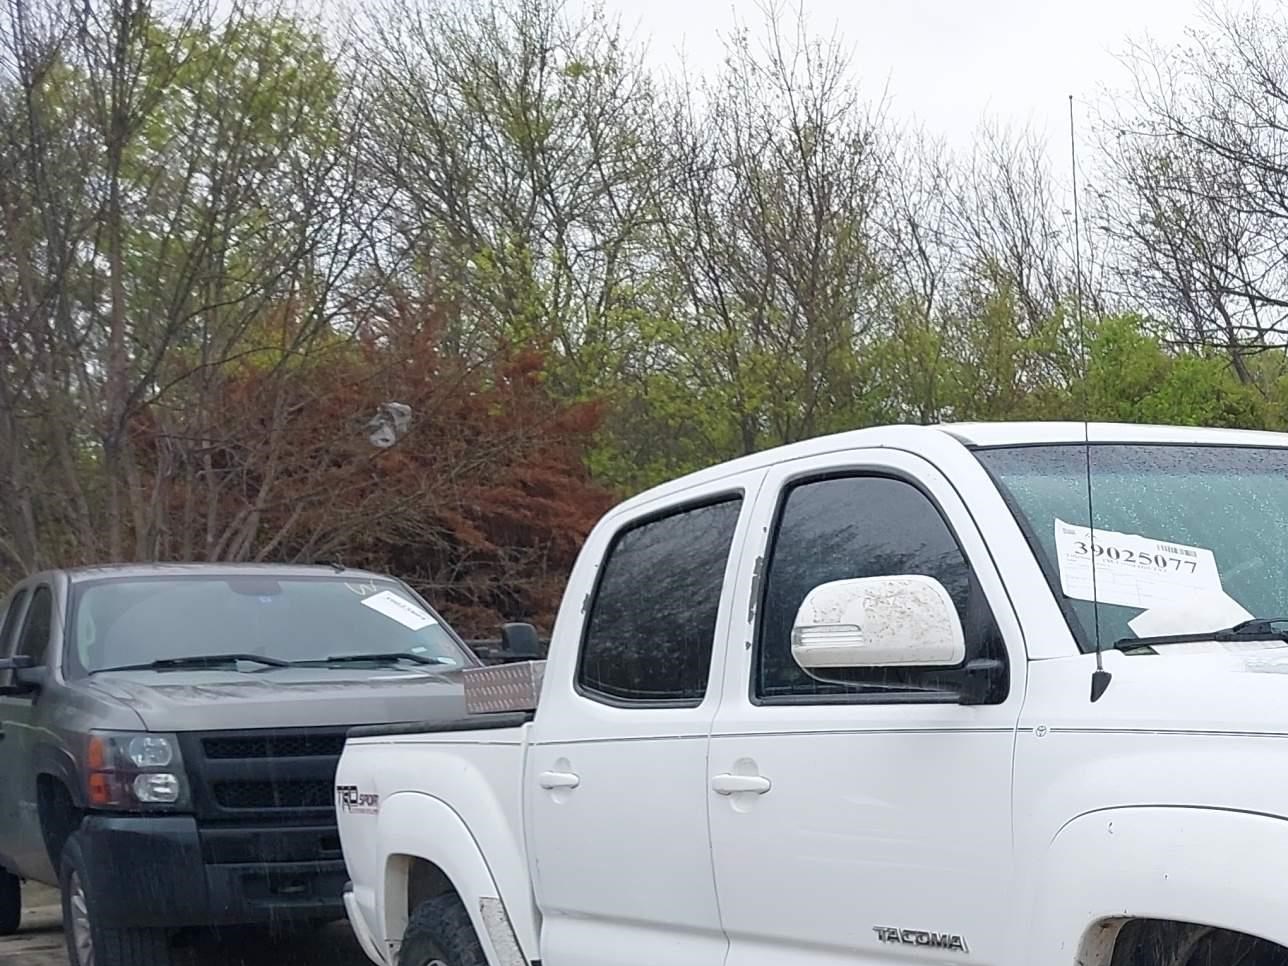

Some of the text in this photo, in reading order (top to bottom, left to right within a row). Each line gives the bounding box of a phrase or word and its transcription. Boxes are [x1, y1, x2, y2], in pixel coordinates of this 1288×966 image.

[1073, 540, 1197, 573] 39025077
[336, 785, 359, 811] TRD
[872, 924, 969, 953] TACOMA
